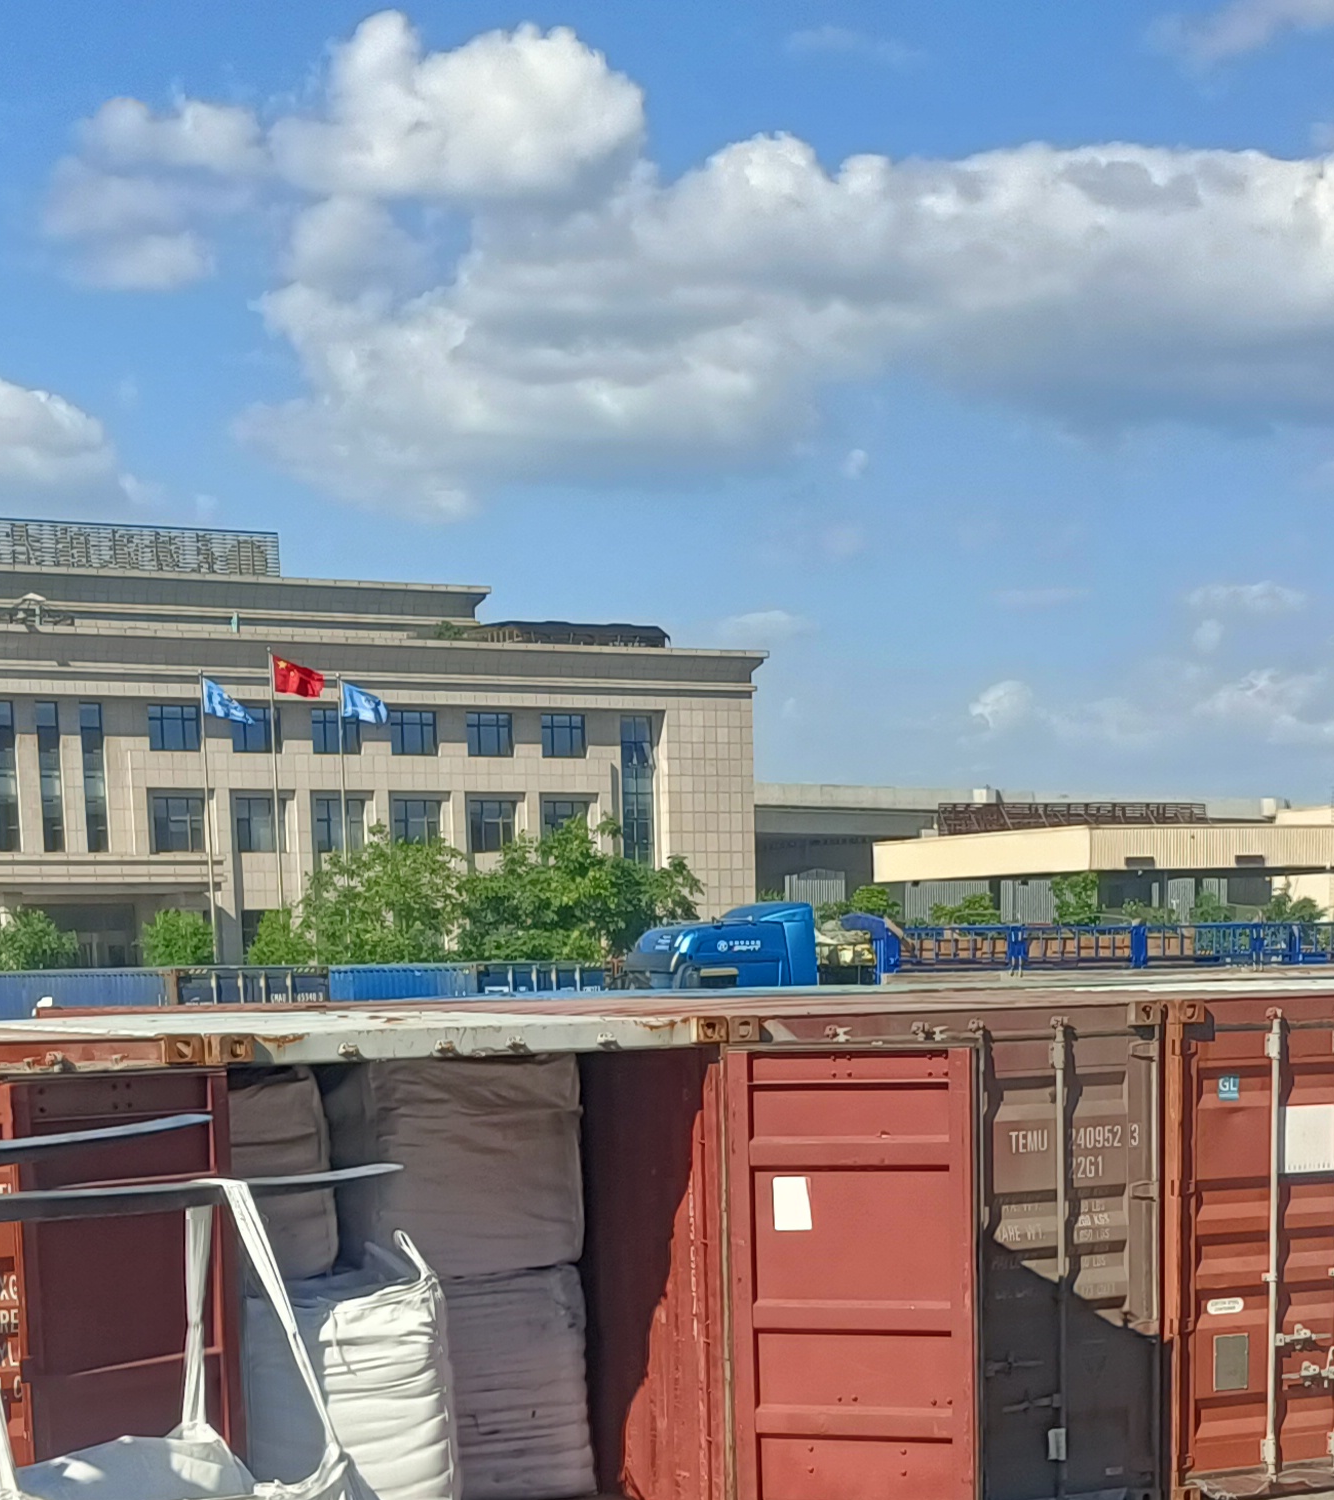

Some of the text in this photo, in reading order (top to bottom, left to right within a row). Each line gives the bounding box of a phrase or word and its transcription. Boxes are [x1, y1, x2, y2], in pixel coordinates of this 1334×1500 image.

[1218, 1077, 1239, 1091] GL
[1009, 1129, 1049, 1154] TEMU
[1130, 1123, 1140, 1147] 3
